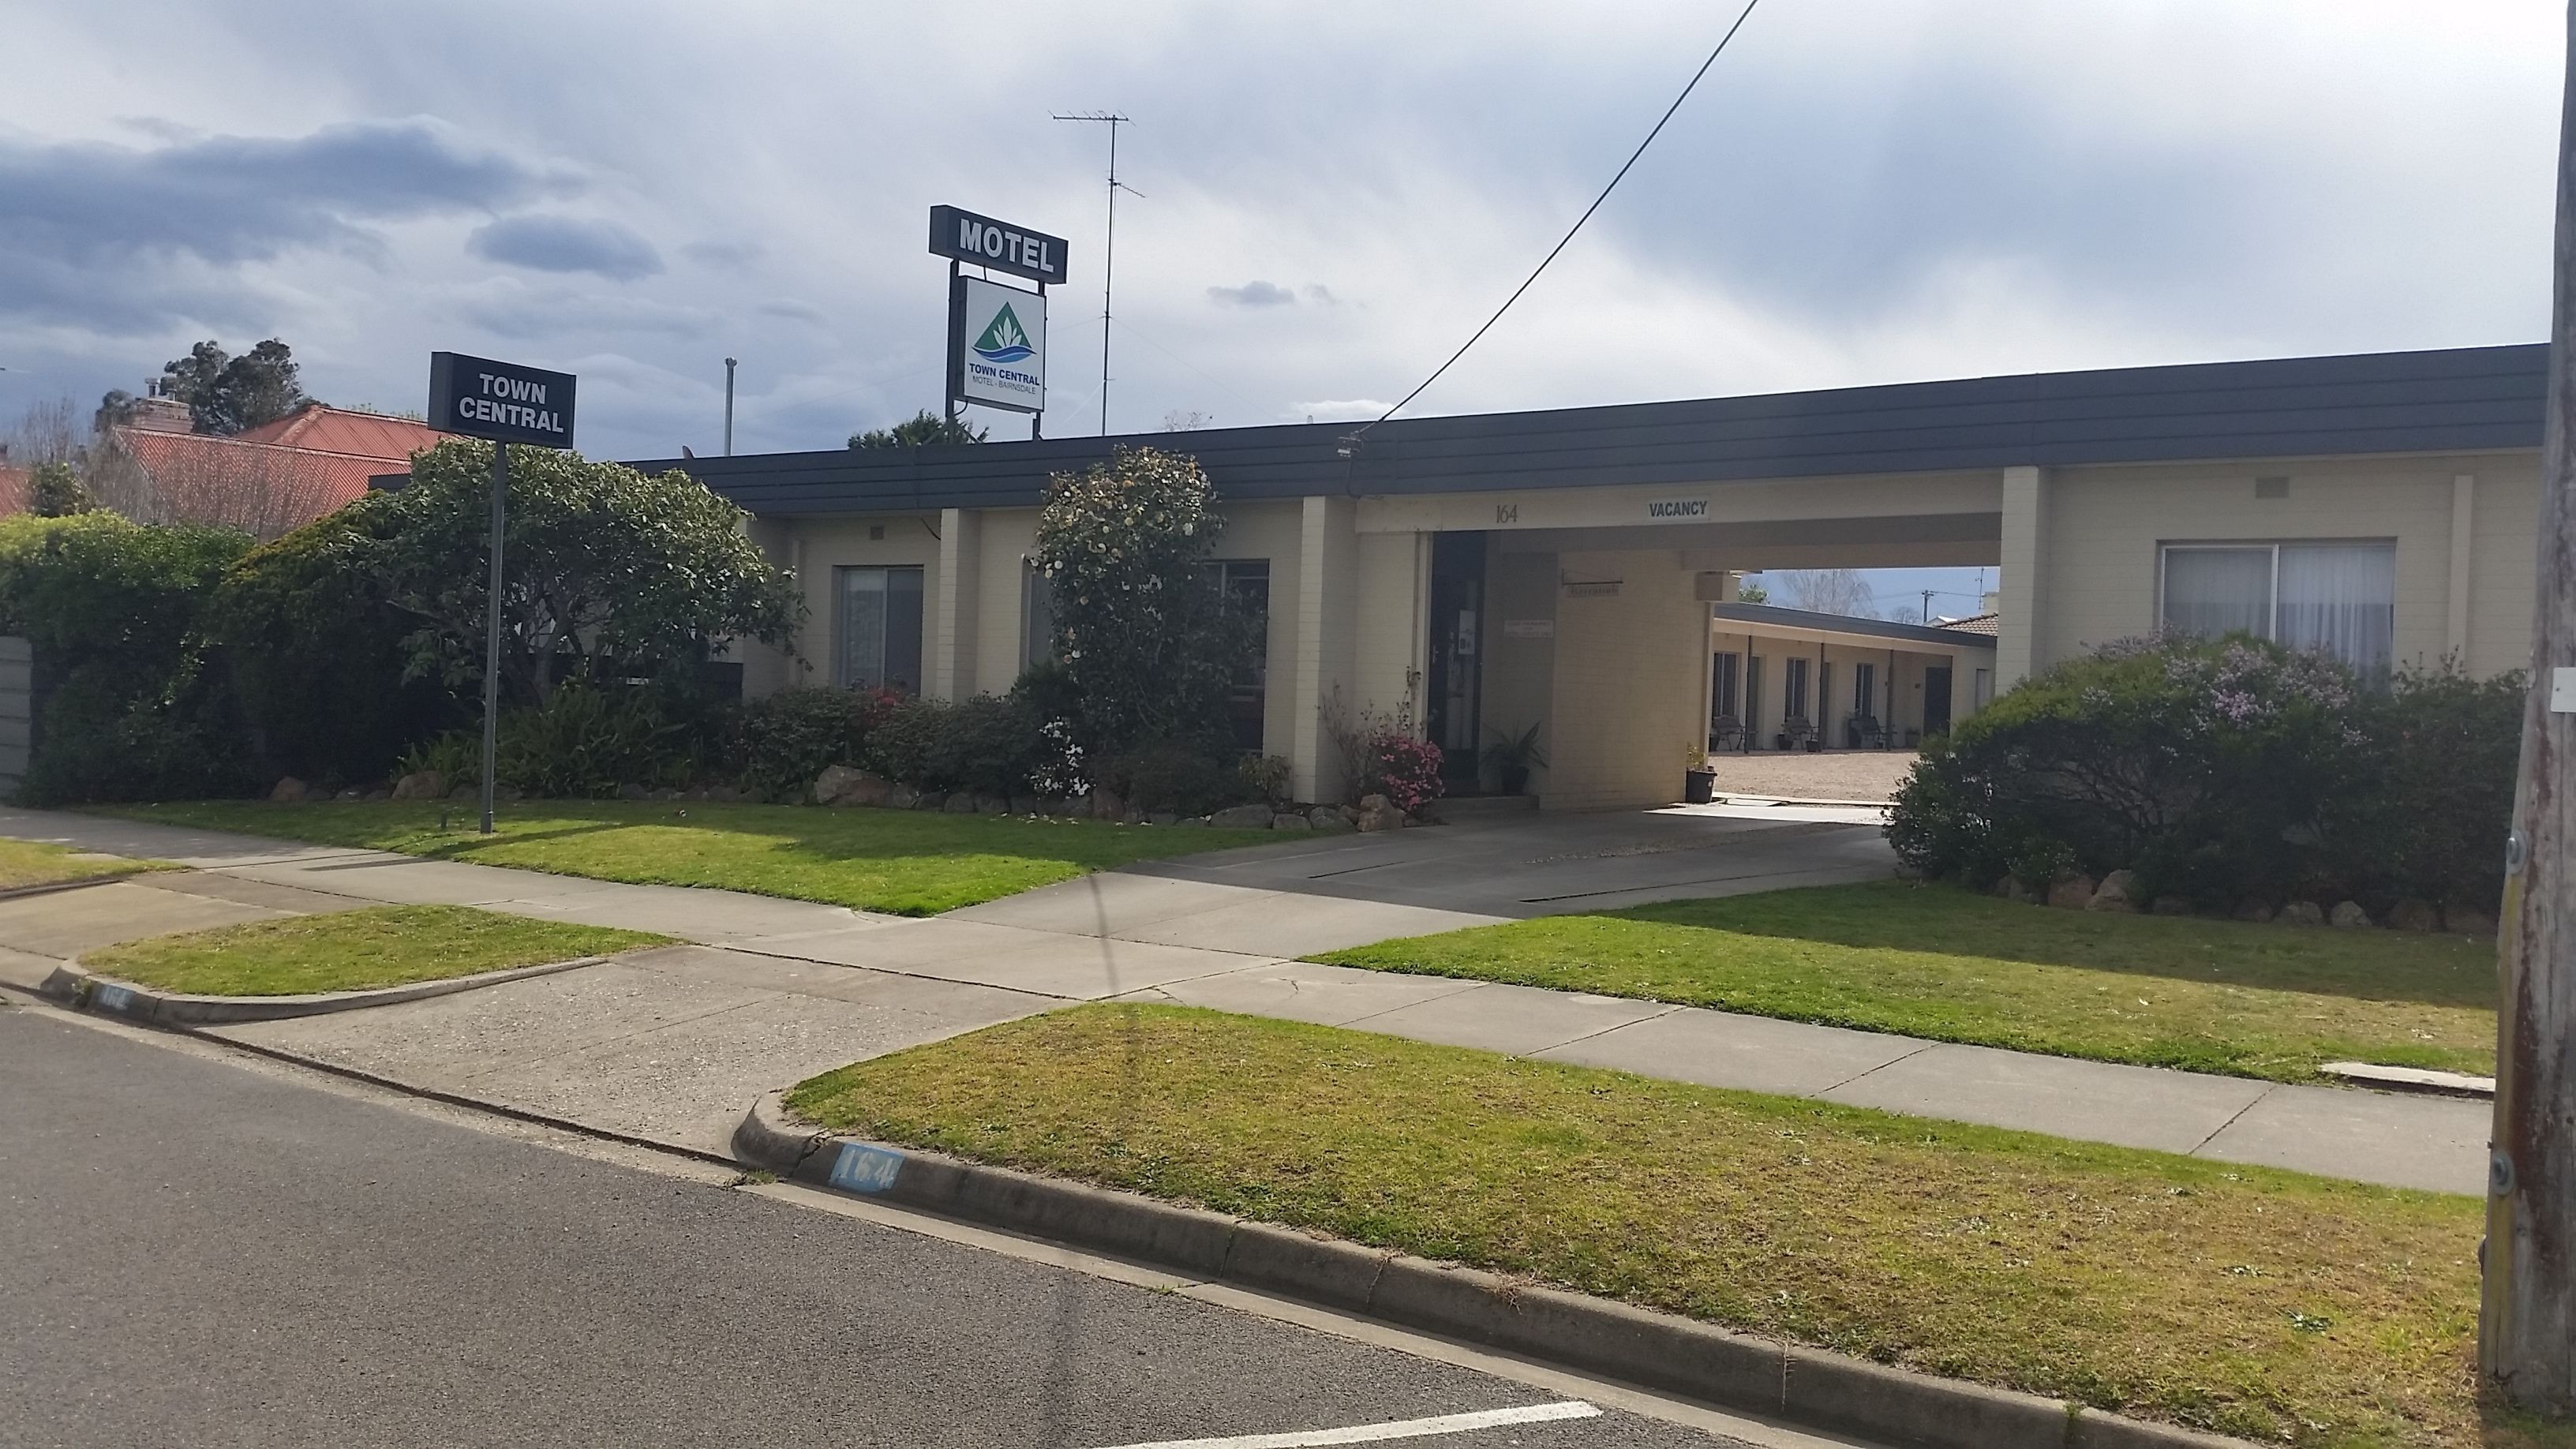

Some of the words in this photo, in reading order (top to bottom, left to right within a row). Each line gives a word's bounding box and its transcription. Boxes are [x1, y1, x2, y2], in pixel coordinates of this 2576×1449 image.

[960, 219, 1054, 273] MOTEL
[969, 363, 996, 377] TOWN
[999, 369, 1040, 386] CENTRAL
[972, 375, 994, 387] MOTEL
[998, 380, 1036, 395] BAIRNSDALE
[479, 373, 546, 405] TOWN
[459, 396, 564, 433] CENTRAL
[1496, 504, 1518, 524] 164
[1649, 500, 1708, 518] VACANCY
[839, 1149, 895, 1189] 164
